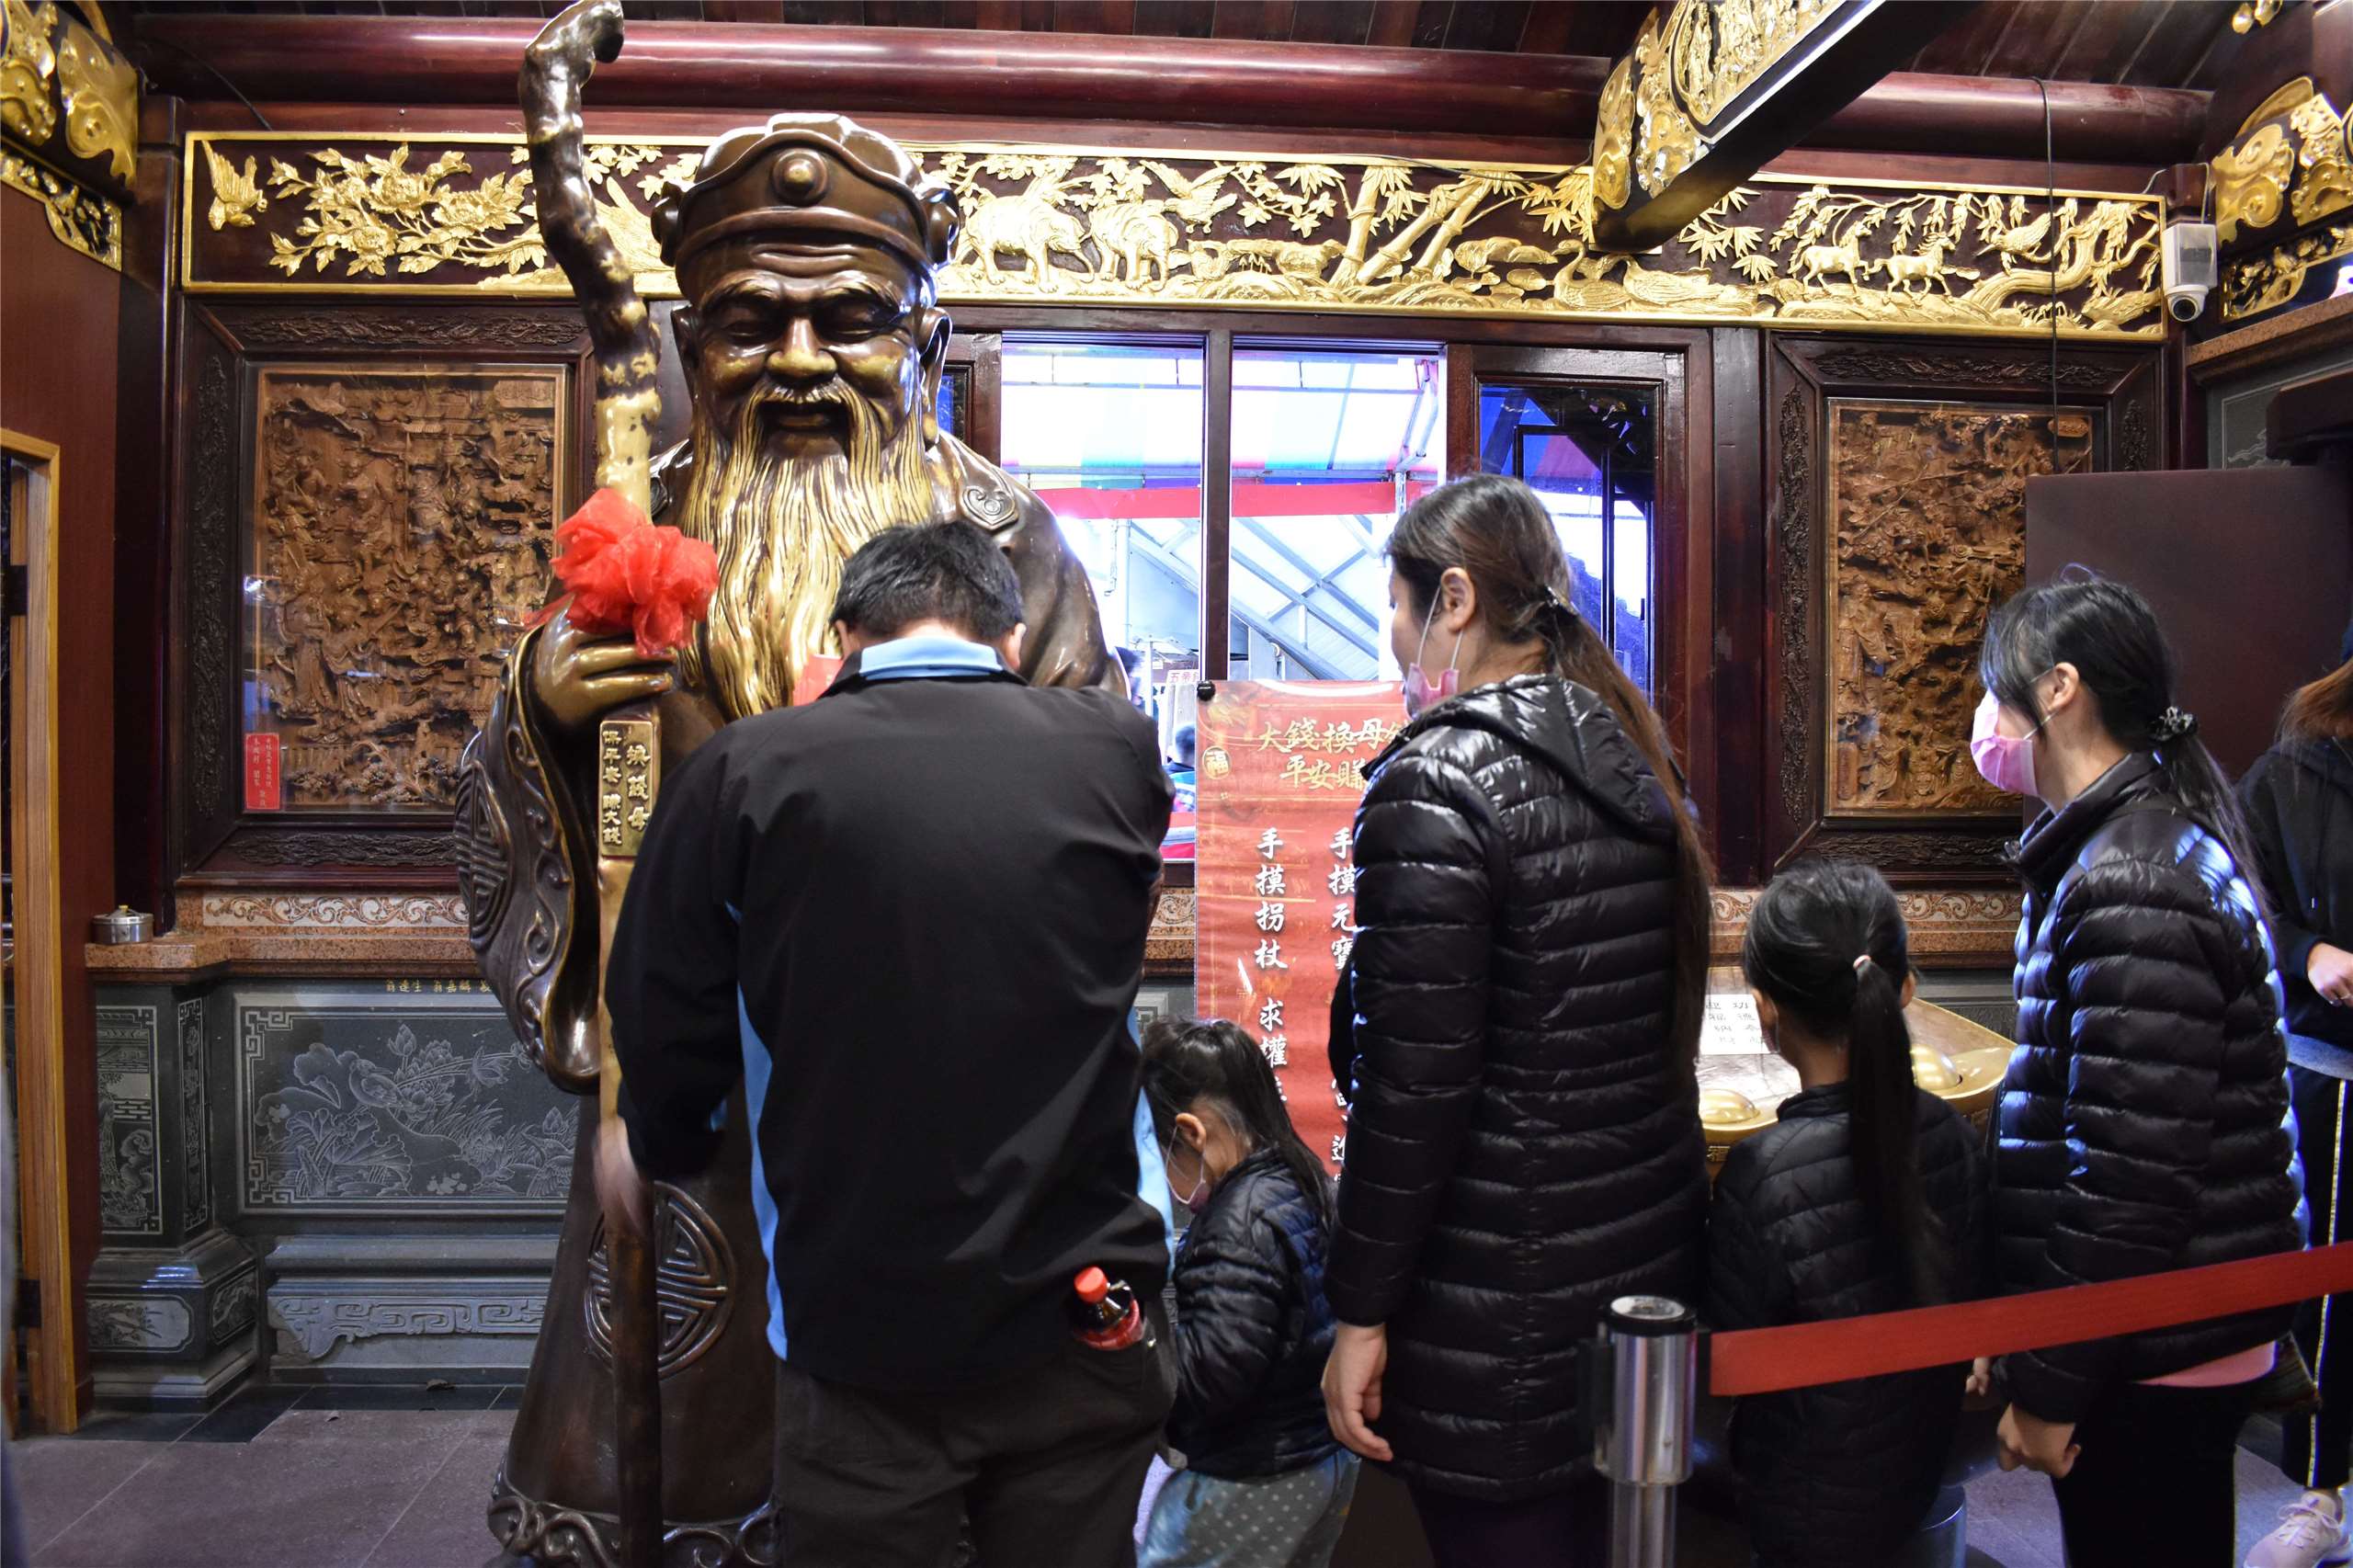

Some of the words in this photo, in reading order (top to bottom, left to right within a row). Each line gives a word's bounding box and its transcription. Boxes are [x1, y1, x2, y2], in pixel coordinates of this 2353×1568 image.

[1254, 826, 1289, 971] 手摸拐杖
[1258, 996, 1289, 1103] 求權
